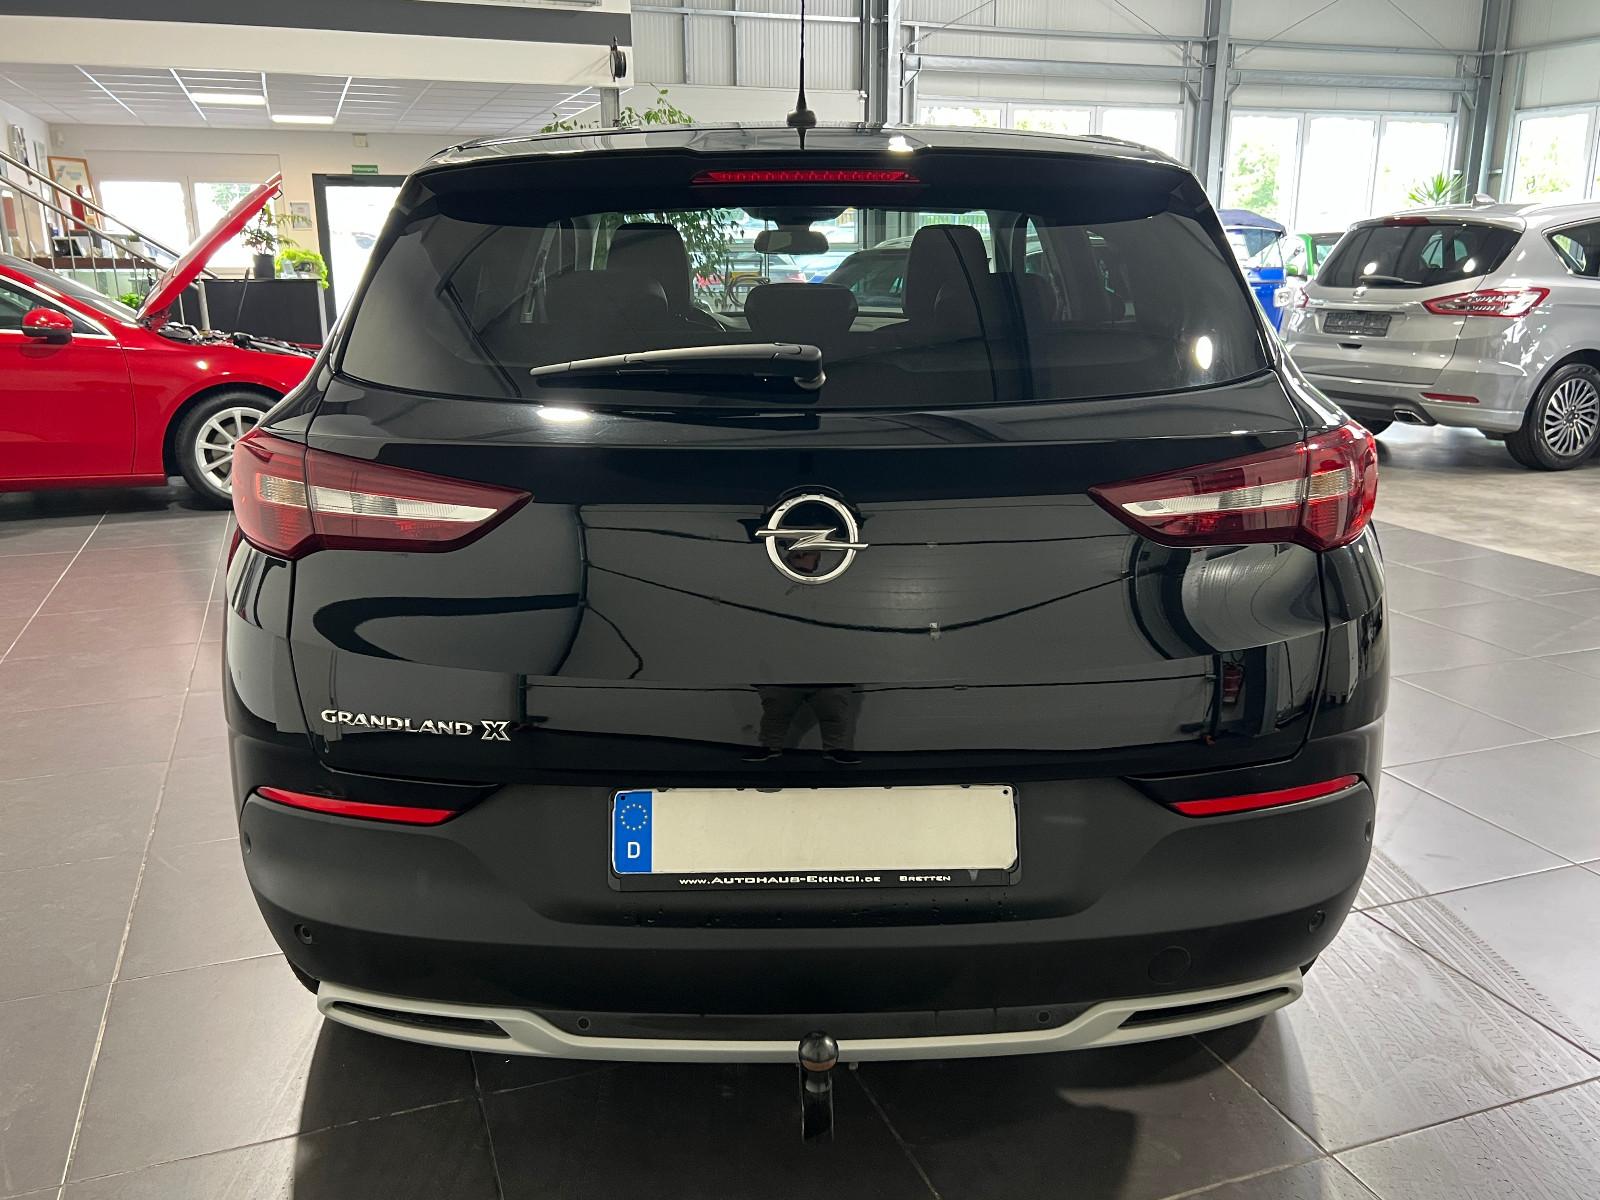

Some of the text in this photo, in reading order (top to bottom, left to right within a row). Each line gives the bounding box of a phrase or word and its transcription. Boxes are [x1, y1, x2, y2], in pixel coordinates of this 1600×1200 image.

[321, 709, 511, 741] GRANDLAND X
[627, 841, 641, 858] D
